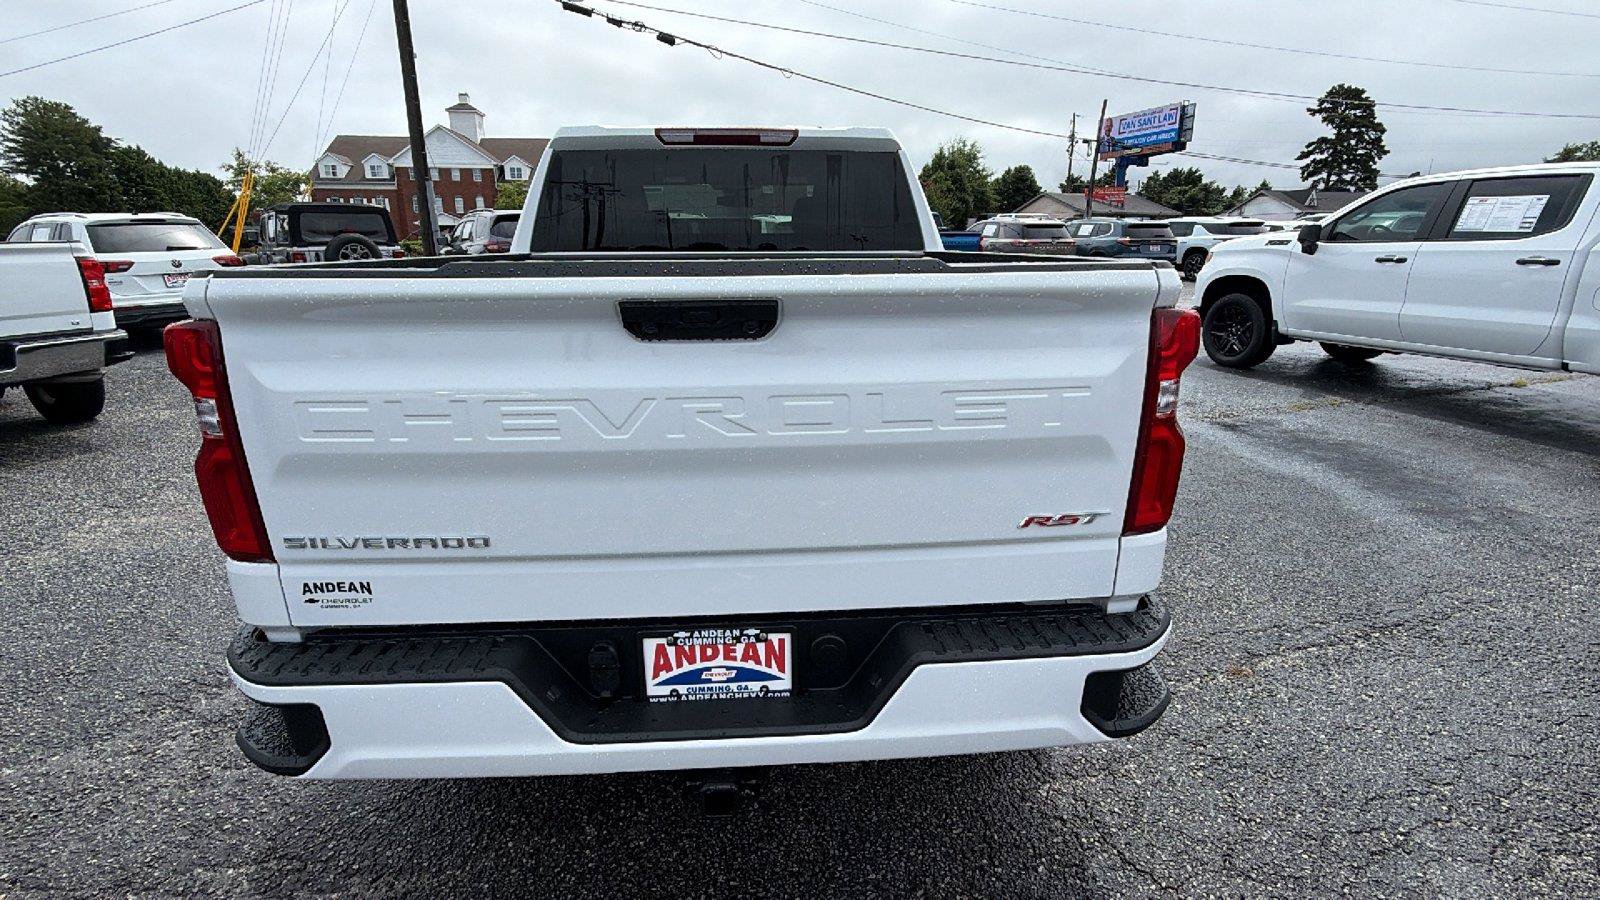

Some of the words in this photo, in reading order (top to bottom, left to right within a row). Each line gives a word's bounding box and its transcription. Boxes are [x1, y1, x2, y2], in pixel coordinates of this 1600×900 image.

[1122, 119, 1136, 130] VAN
[1137, 115, 1158, 128] SANT
[1158, 110, 1176, 123] LAW
[294, 386, 1091, 442] CHEVROLET
[1017, 510, 1112, 528] RST
[283, 536, 491, 550] SILVERADO
[302, 581, 373, 595] ANDEAN
[693, 629, 741, 638] ANDEAN
[677, 637, 738, 646] CUMMING,
[741, 636, 756, 644] GA
[651, 637, 786, 681] ANDEAN
[686, 685, 734, 694] CUMMING,
[737, 684, 753, 693] GA.
